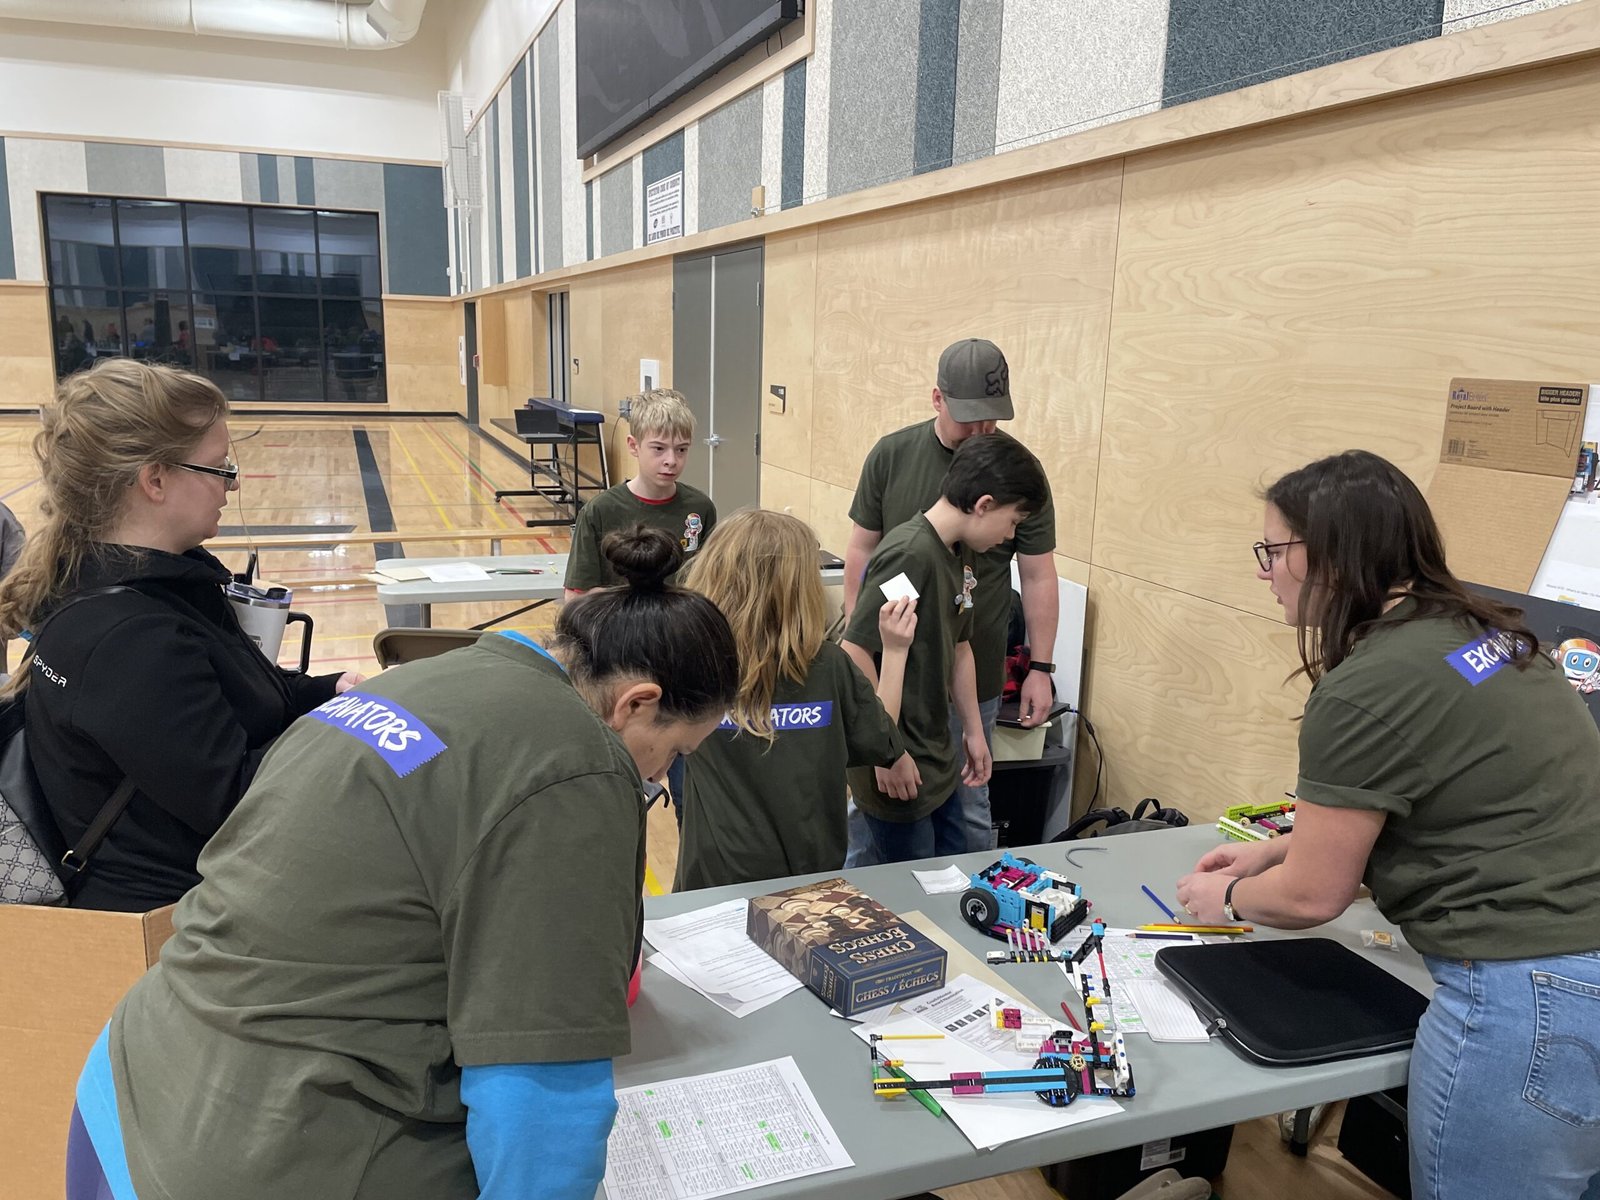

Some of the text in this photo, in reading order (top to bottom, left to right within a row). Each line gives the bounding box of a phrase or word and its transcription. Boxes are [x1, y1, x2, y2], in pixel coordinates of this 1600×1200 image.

[1462, 632, 1524, 673] EXCAV
[33, 654, 67, 688] SPYDER
[314, 696, 422, 752] CAVATORS
[828, 927, 909, 954] ÉCHECS
[849, 940, 916, 964] CHESS
[855, 985, 890, 1003] CHESS
[891, 982, 898, 993] /
[898, 971, 939, 991] ÉCHECS
